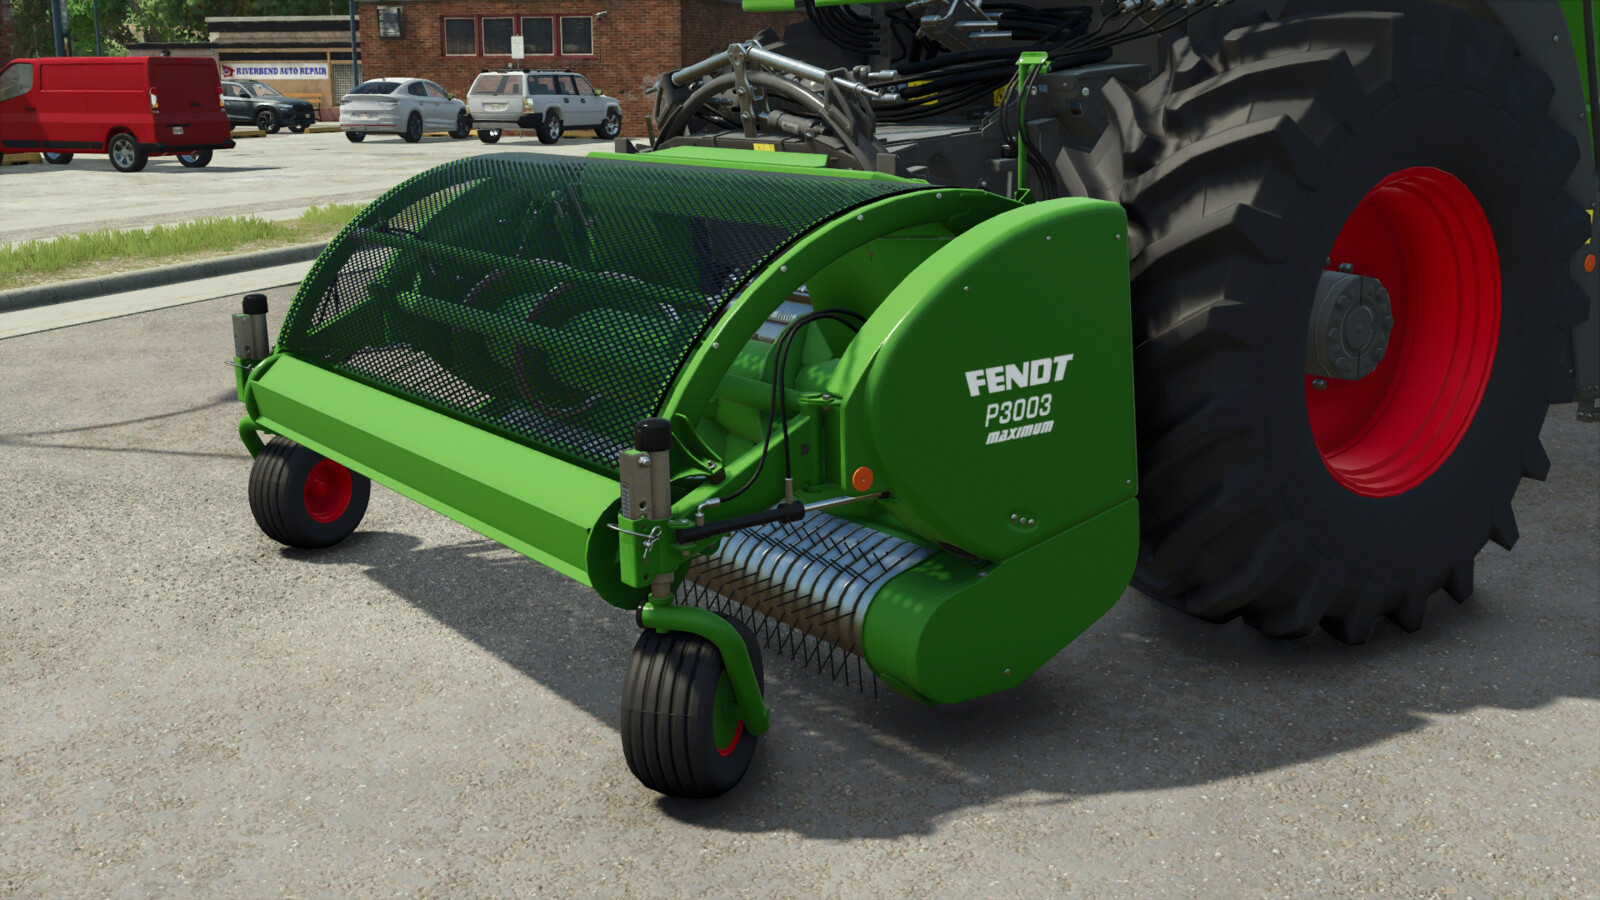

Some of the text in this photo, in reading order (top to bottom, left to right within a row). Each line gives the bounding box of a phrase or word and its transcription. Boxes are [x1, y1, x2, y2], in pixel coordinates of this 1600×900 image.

[236, 67, 327, 75] RIVERBEND AUTO REPAIR
[965, 353, 1074, 397] FENDT
[985, 393, 1052, 428] P3003
[985, 420, 1054, 445] maximum
